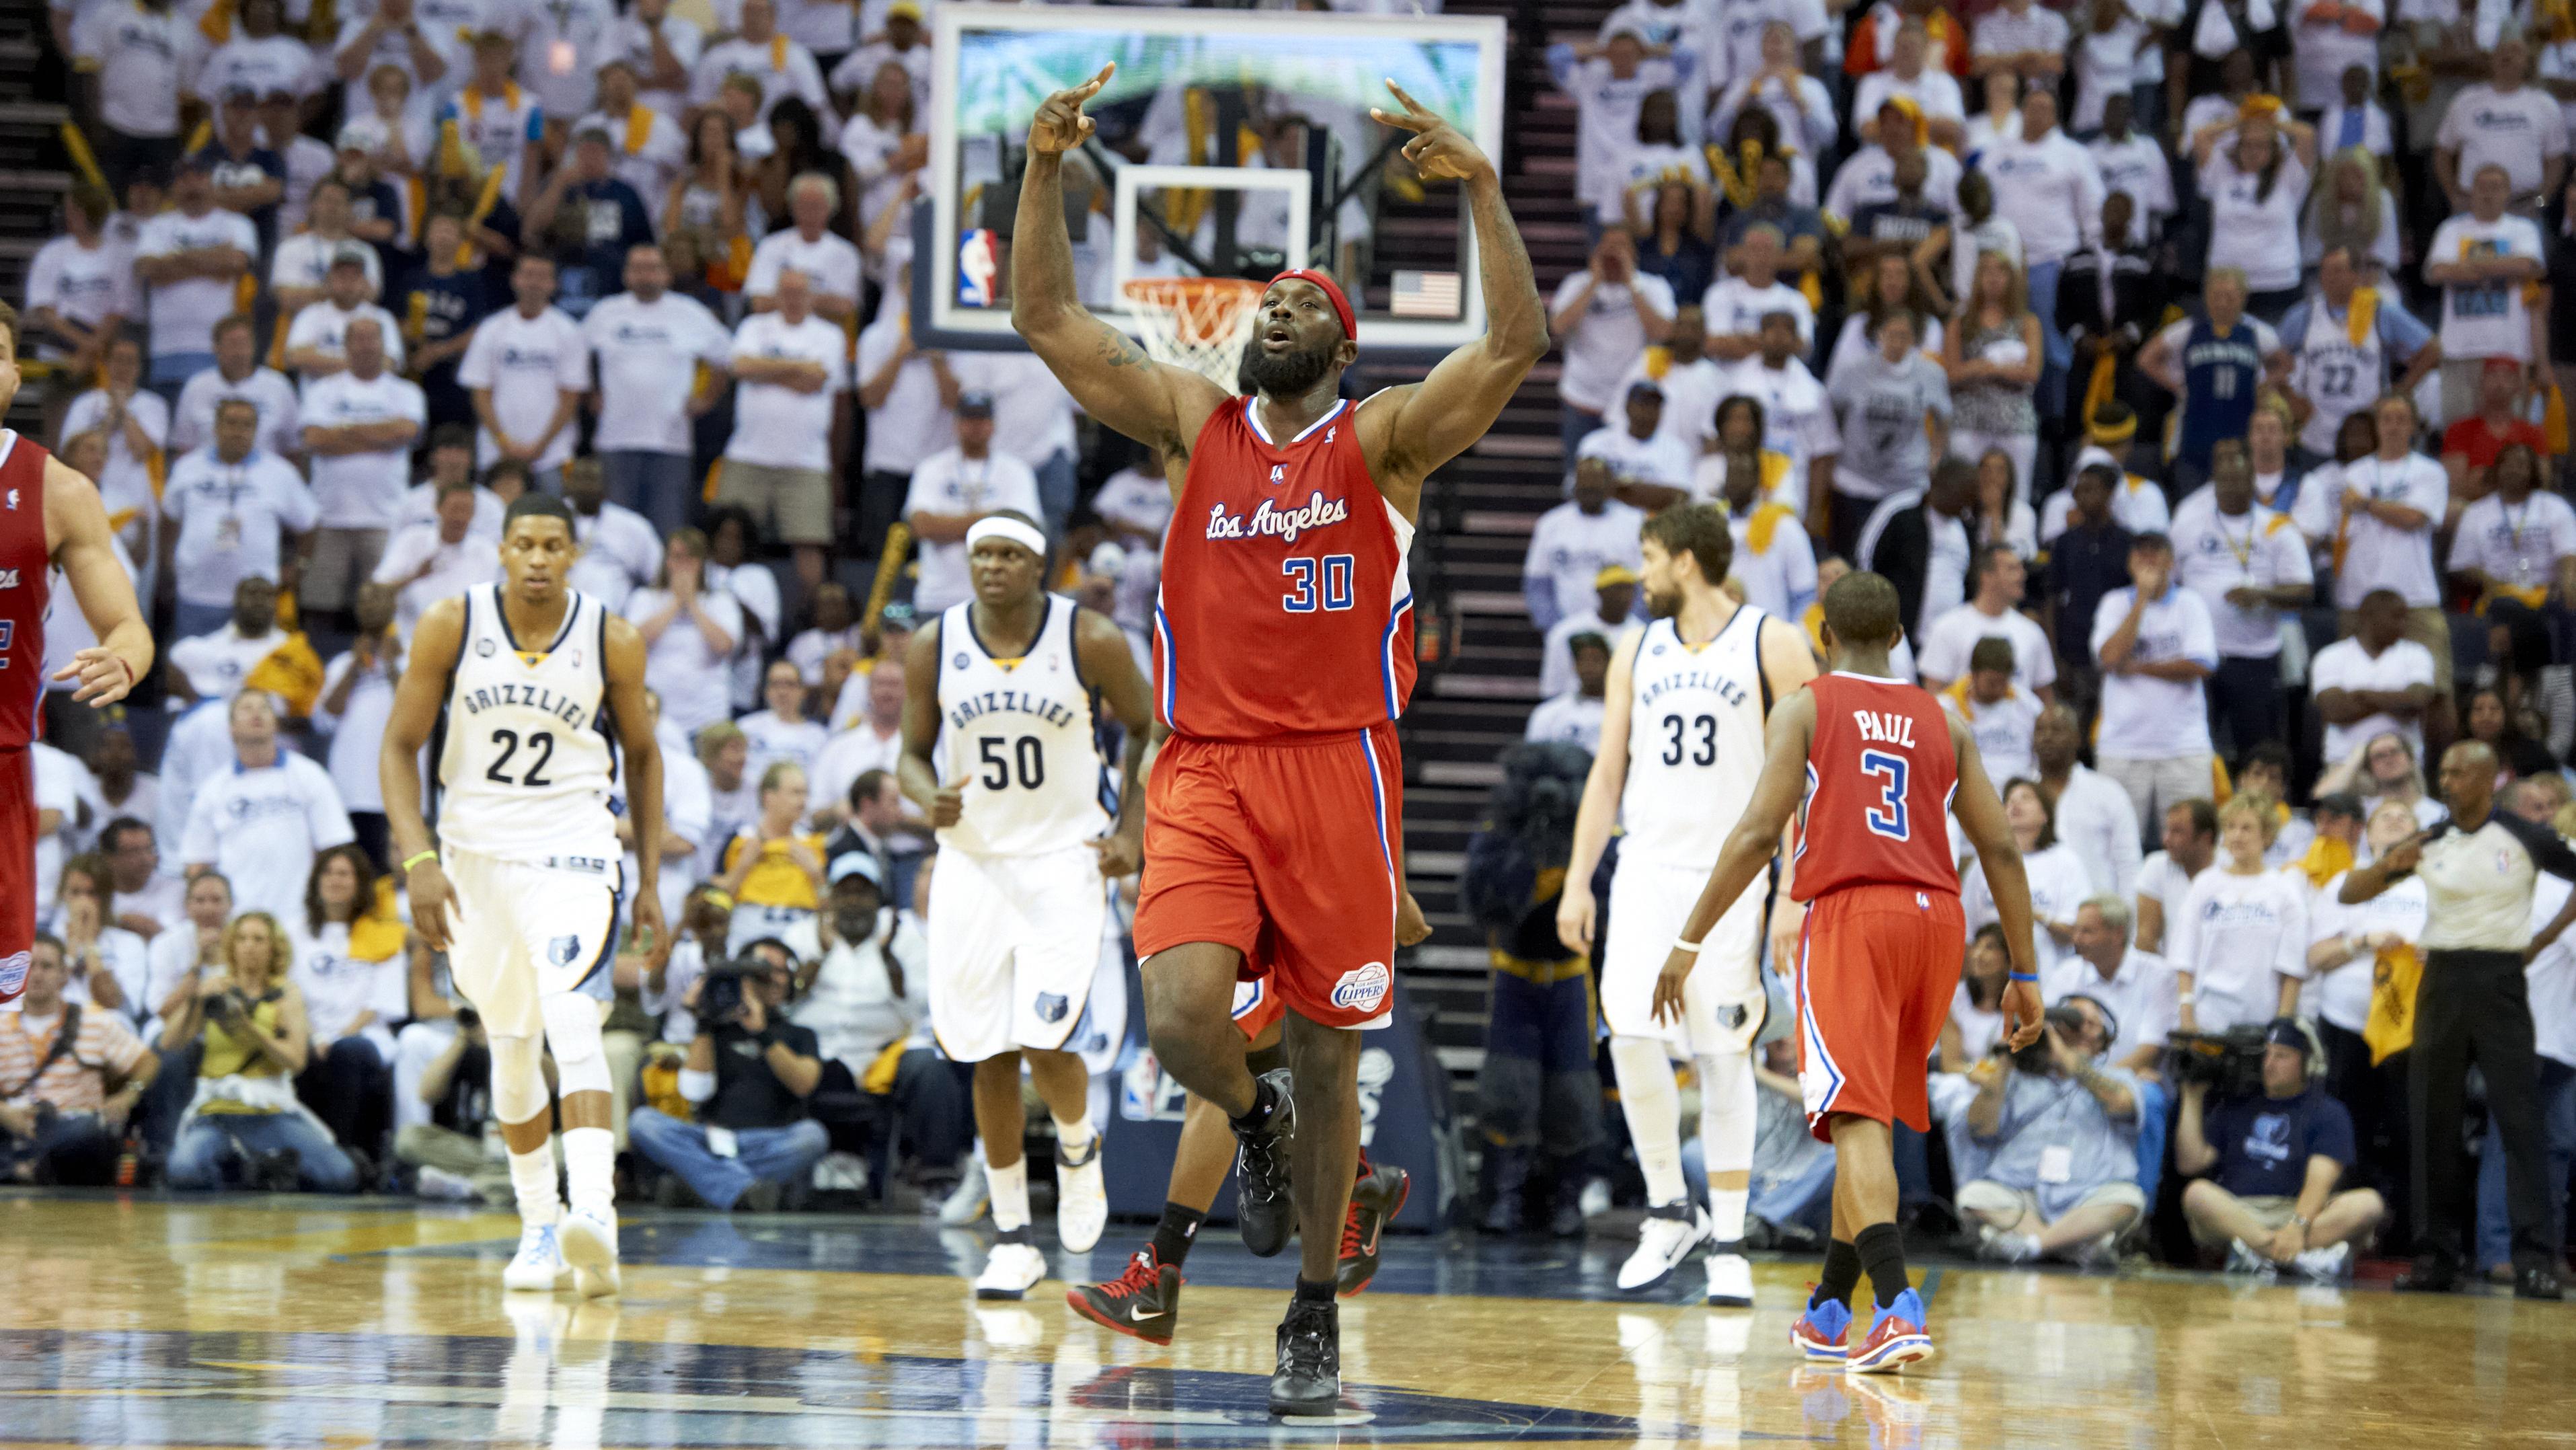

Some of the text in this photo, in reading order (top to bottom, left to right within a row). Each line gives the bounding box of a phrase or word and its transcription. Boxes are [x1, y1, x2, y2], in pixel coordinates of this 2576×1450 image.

[1205, 490, 1349, 543] Los Angeles
[1283, 554, 1355, 613] 30
[464, 684, 586, 730] GRIZZLIES
[950, 691, 1073, 730] GRIZZLIES
[1642, 671, 1747, 707] GRIZZLIES
[1663, 714, 1716, 767] 33
[1853, 710, 1916, 749] PAUL
[486, 729, 554, 787] 22
[979, 735, 1045, 791] 50
[1860, 748, 1910, 842] 3
[1334, 983, 1384, 1006] CLIPPERS
